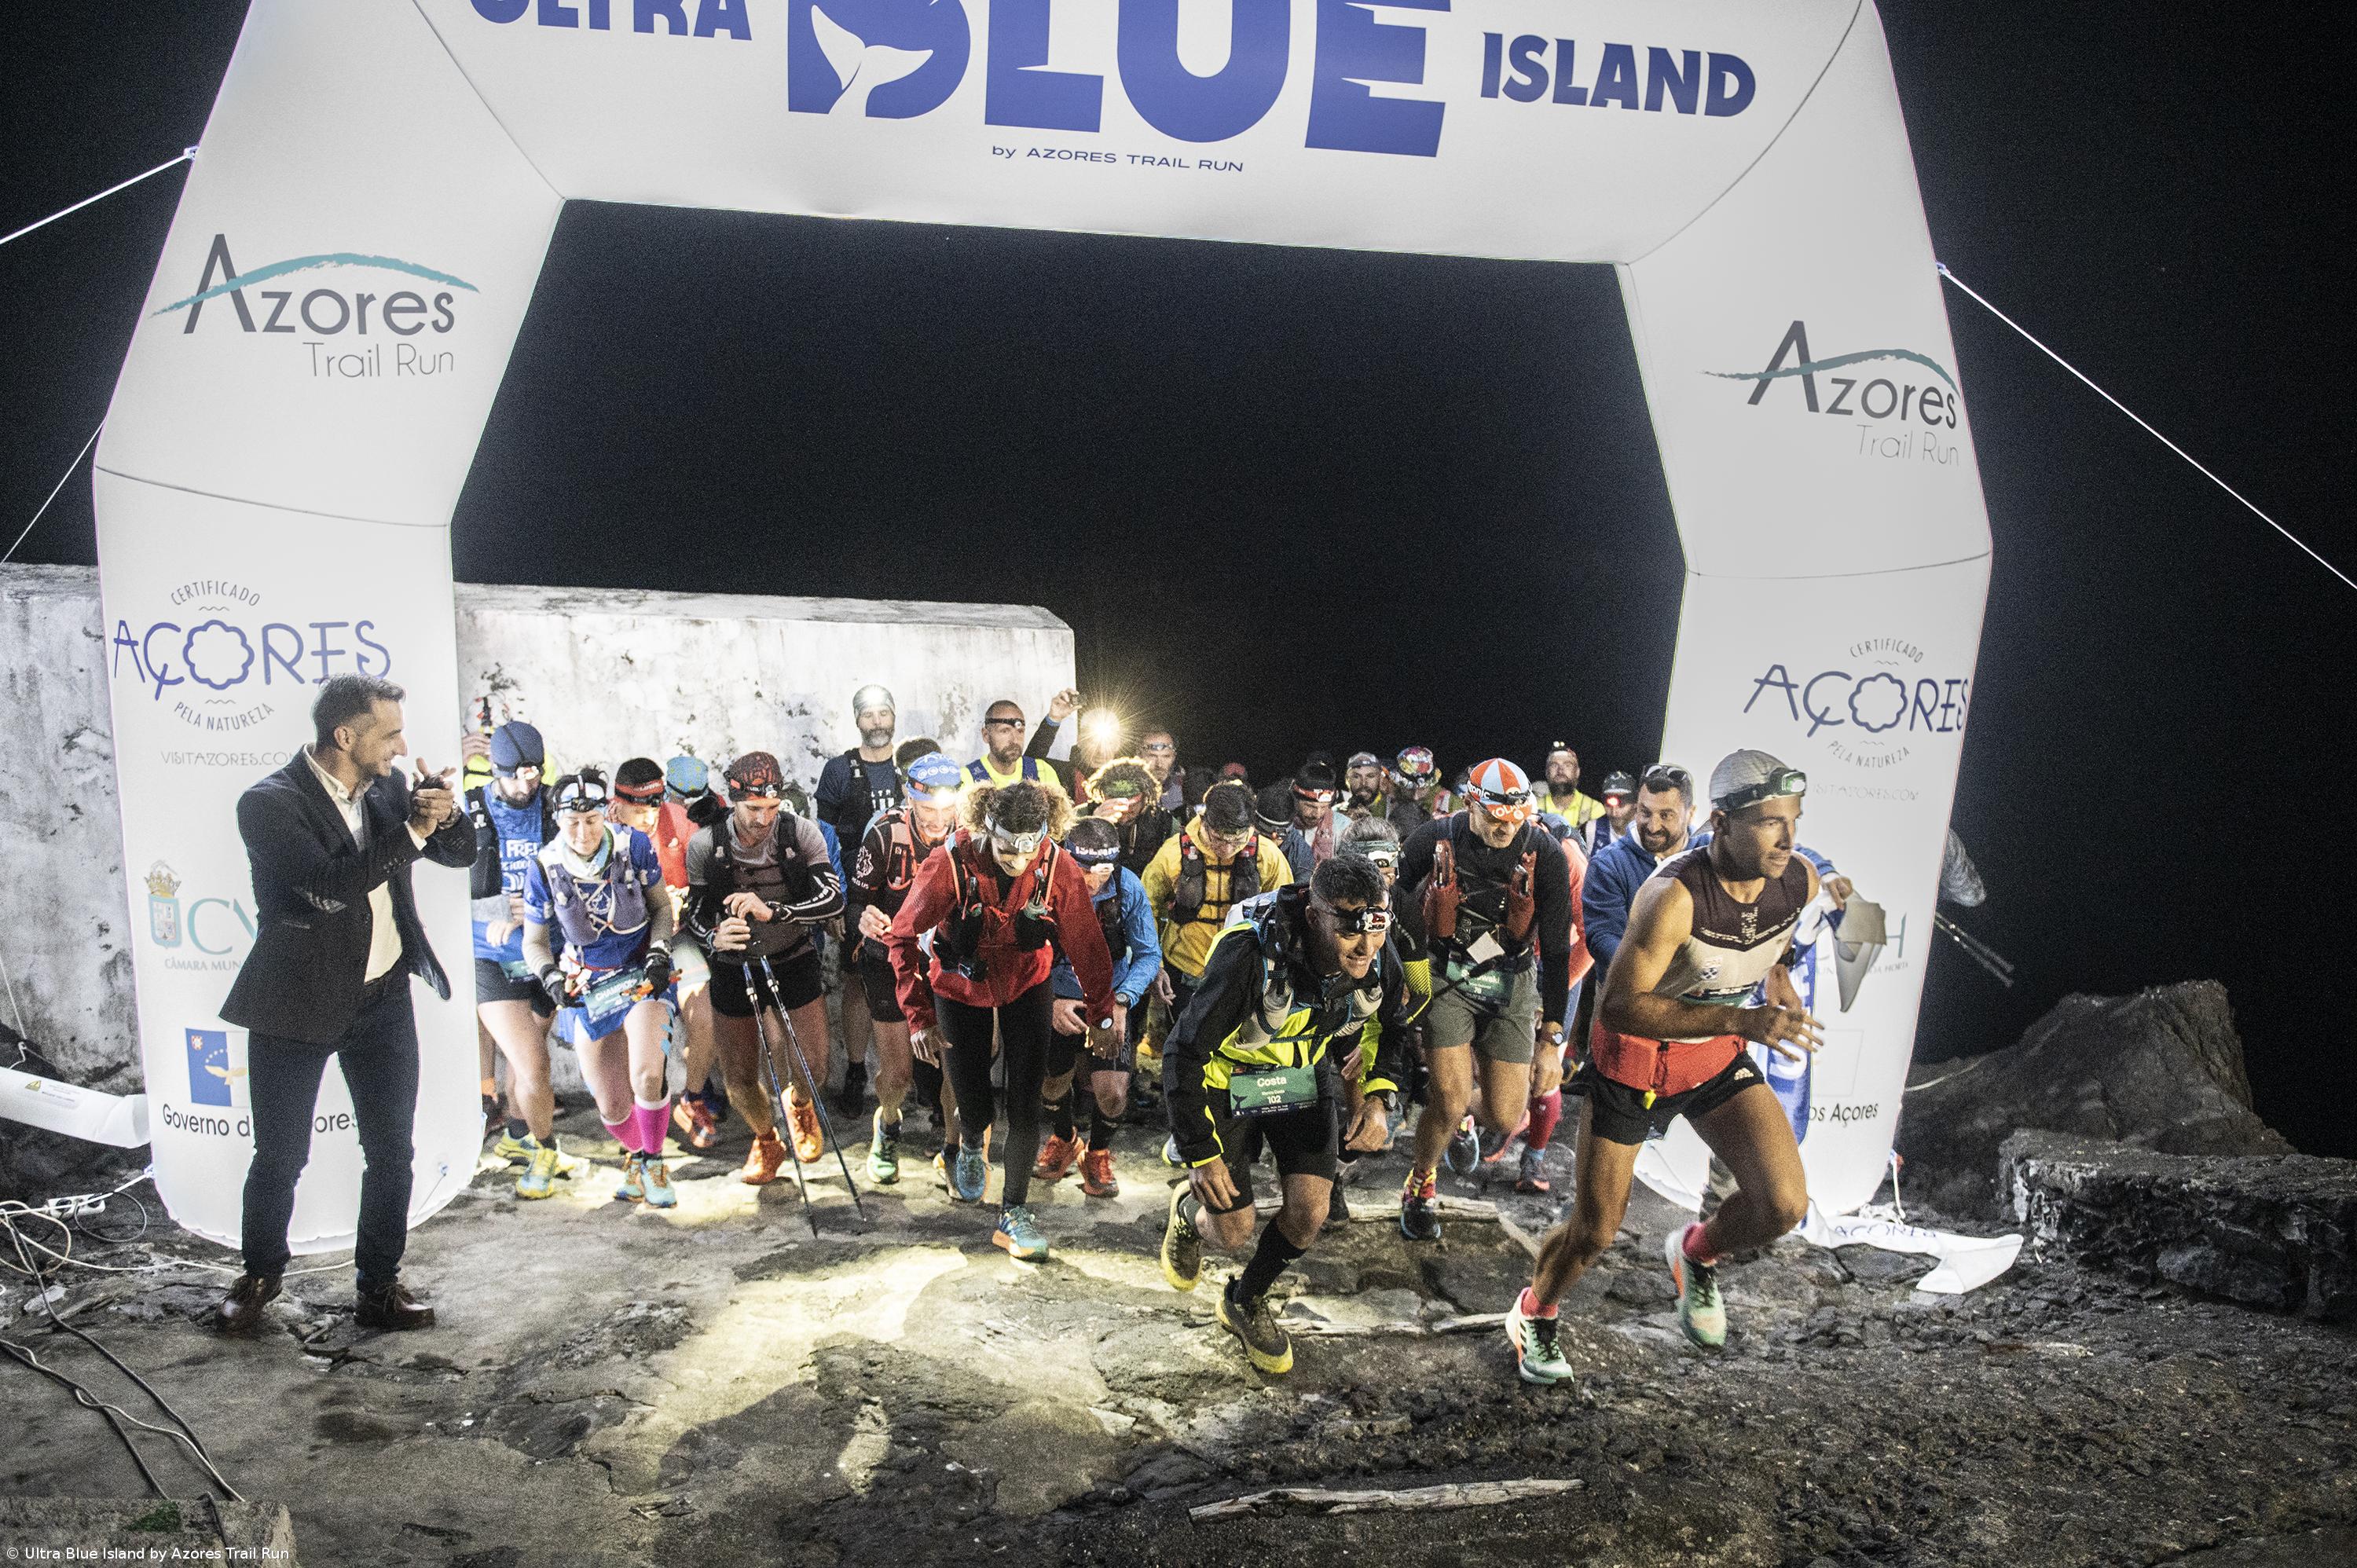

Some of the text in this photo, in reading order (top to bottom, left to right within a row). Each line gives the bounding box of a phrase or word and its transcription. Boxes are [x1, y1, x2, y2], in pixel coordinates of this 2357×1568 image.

[1481, 31, 1756, 118] ISLAND
[992, 146, 1244, 172] by AZORES TRAIL RUN
[184, 233, 455, 335] Azores
[302, 342, 454, 378] Trail Run
[1747, 321, 1956, 429] Azores
[1857, 424, 1959, 467] Trail Run
[170, 580, 261, 606] CERTIFICADO
[1849, 638, 1924, 663] CERTIFICADO
[174, 702, 275, 731] PELA NATUREZA
[160, 751, 294, 767] VISITAZORES.CO
[1827, 740, 1911, 768] PELA NATUREZA
[1257, 1076, 1287, 1087] Costa
[1267, 1095, 1281, 1105] 102
[163, 1103, 230, 1137] Governo
[1830, 1103, 1879, 1128] Açores
